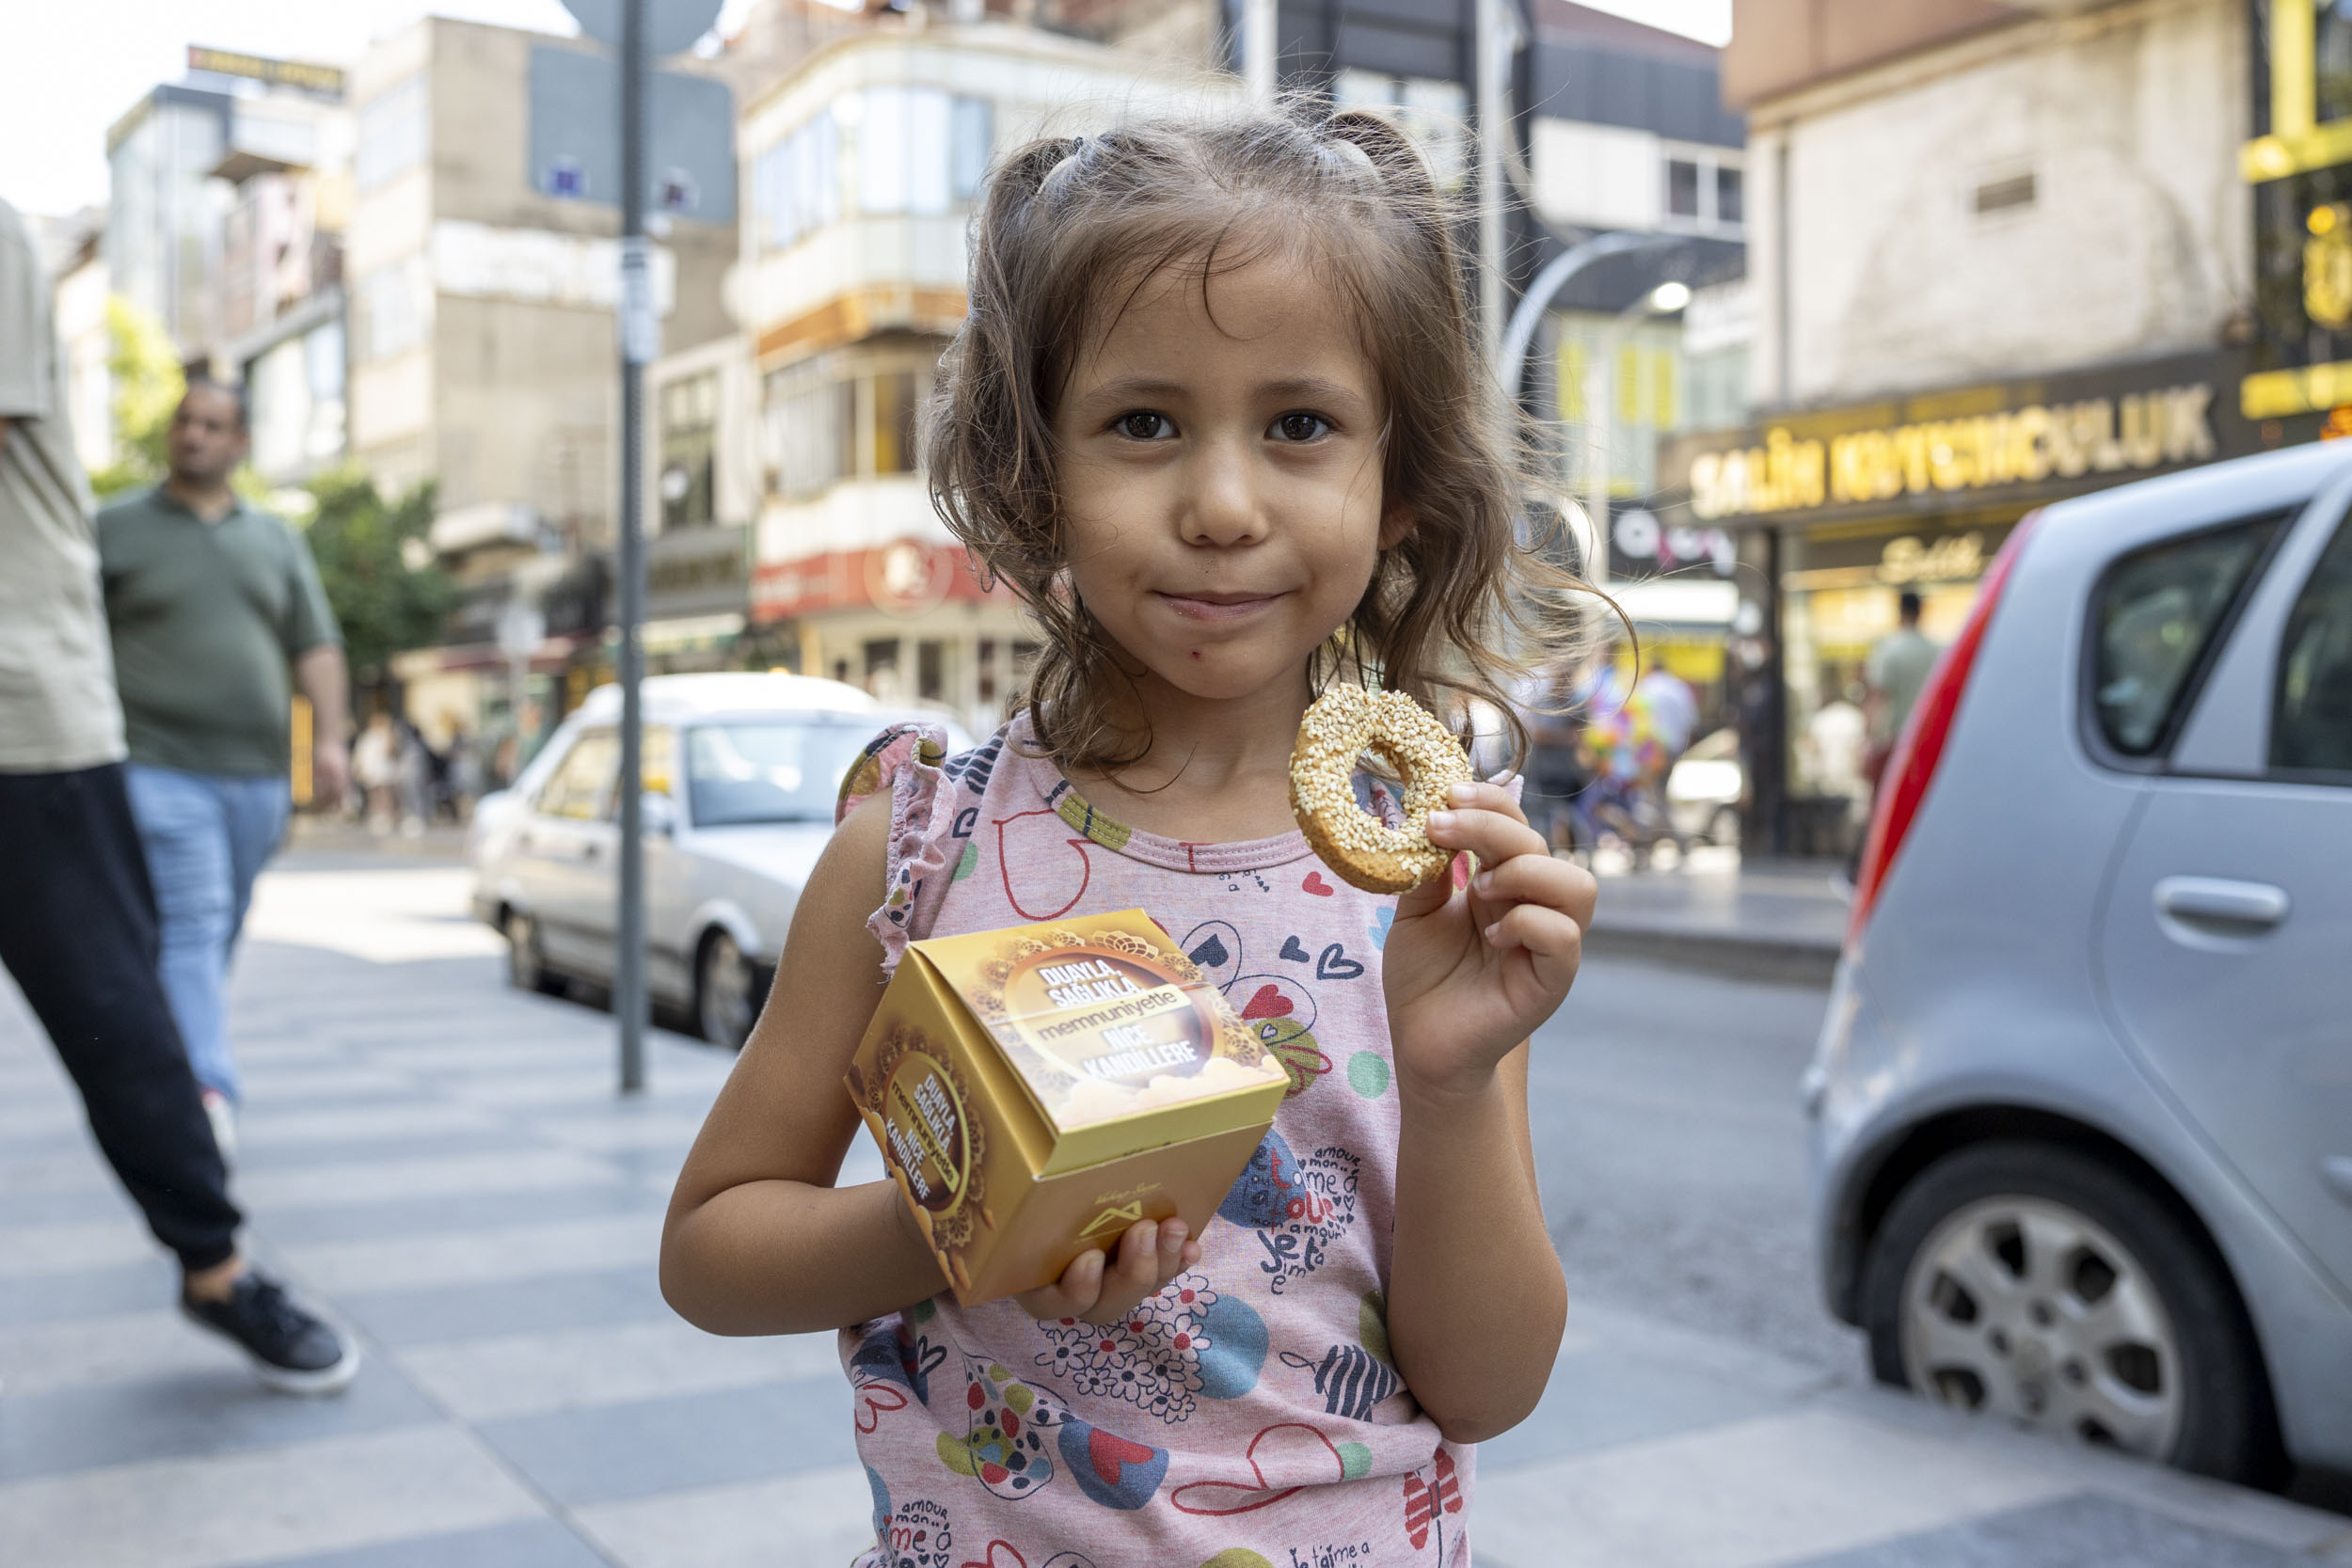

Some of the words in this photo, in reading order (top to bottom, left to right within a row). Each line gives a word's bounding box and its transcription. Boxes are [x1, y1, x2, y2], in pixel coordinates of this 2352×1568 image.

[1039, 959, 1122, 986] DUAYLA,
[1038, 990, 1177, 1040] memnuniyetle
[1102, 1024, 1154, 1050] NİCE
[925, 1073, 956, 1135] DUAYLA,
[892, 1082, 954, 1182] memnuniyetle
[906, 1129, 926, 1165] NİCE
